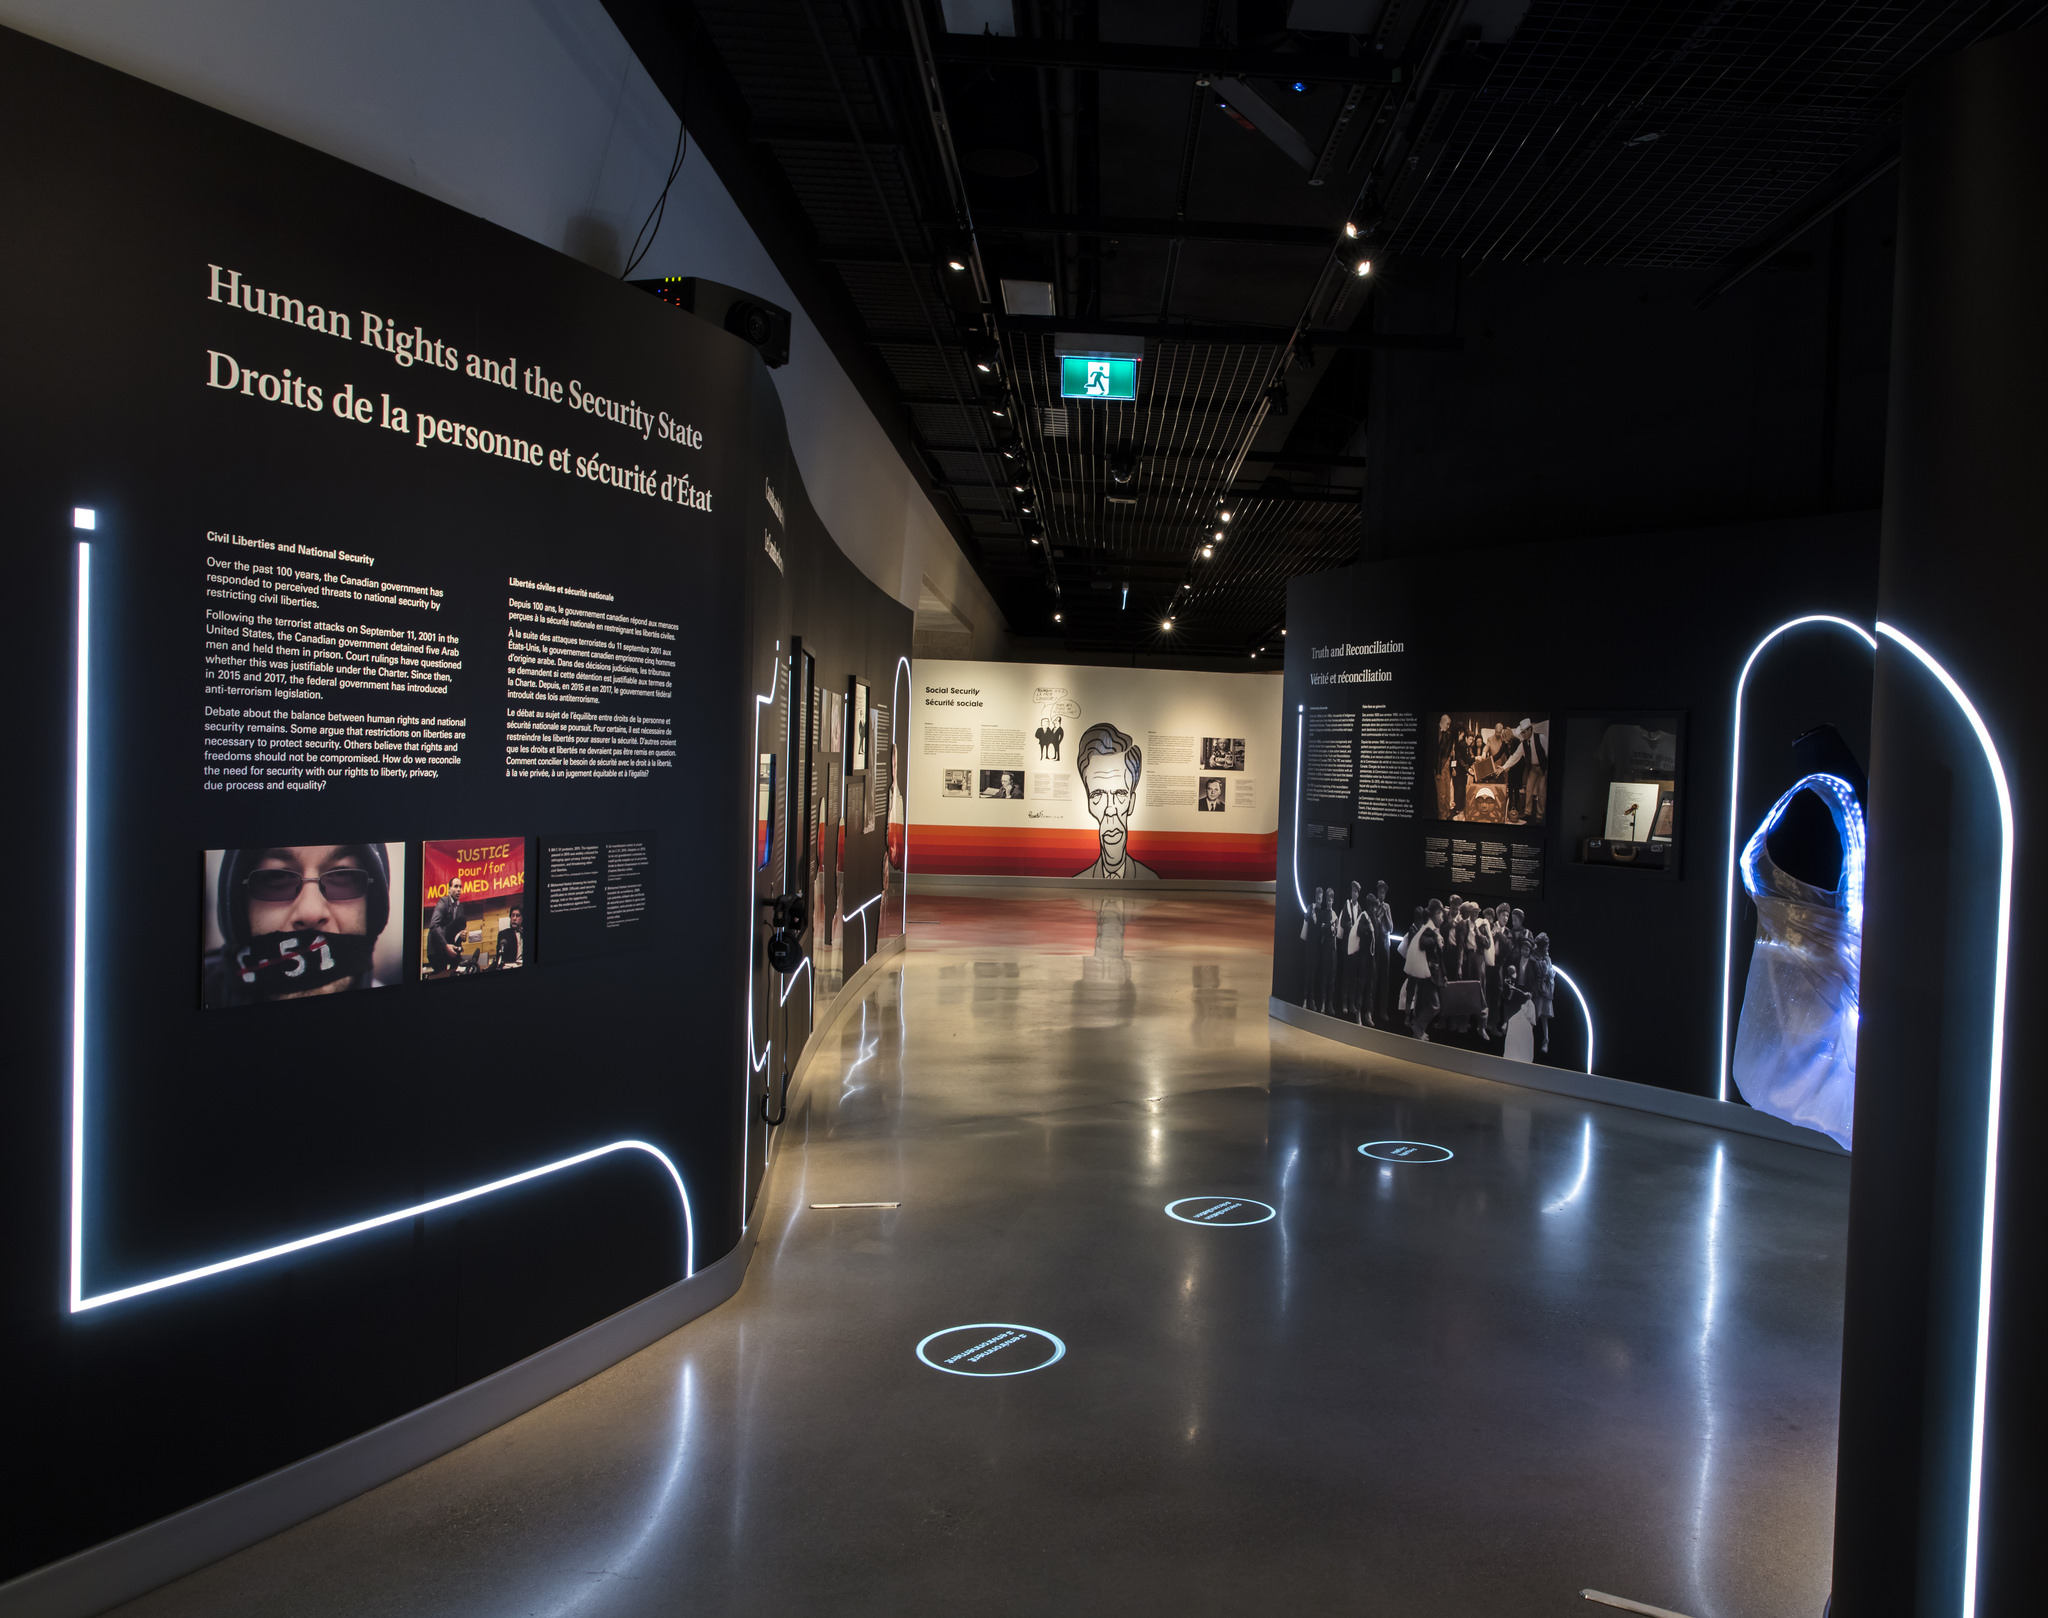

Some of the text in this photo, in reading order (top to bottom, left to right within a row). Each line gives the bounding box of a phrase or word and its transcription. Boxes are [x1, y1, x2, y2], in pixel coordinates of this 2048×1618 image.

[207, 264, 703, 450] Human Rights and the Security State
[206, 350, 323, 412] Droits
[333, 384, 373, 423] de
[380, 394, 410, 433] la
[417, 414, 544, 466] personne
[549, 448, 571, 474] et
[576, 452, 657, 497] sécurité
[207, 531, 375, 567] Civil Liberties and National Security
[207, 557, 444, 597] Over the past 100 years, the Canadian government has
[207, 574, 441, 612] responded to perceived threats to national security by
[207, 589, 319, 609] restricting civil liberties.
[509, 577, 614, 602] Libertés civiles et sécurité nationale
[206, 609, 459, 644] Following the terrorist attacks on September 11, 2001 in the
[206, 624, 460, 657] United States, the Canadian government detained five Arab
[1312, 641, 1404, 660] Truth and Reconciliation
[206, 642, 462, 670] men and held them in prison. Court rulings have questioned
[205, 655, 452, 683] whether this was justifiable under the Charter. Since then,
[1310, 669, 1392, 685] Vérité et réconciliation
[205, 684, 323, 700] anti-terrorism legislation.
[206, 669, 448, 694] in 2015 and 2017, the federal government has introduced
[950, 687, 980, 696] Security
[925, 698, 954, 706] Sécurité
[205, 706, 466, 727] Debate about the balance between human rights and national
[205, 722, 245, 734] security
[247, 724, 288, 733] remains.
[291, 724, 318, 734] Some
[319, 727, 345, 737] argue
[346, 726, 363, 736] that
[365, 728, 410, 738] restrictions
[423, 729, 453, 739] liberties
[204, 766, 220, 775] the
[223, 766, 248, 775] need
[250, 766, 264, 776] for
[266, 766, 304, 778] security
[305, 767, 325, 776] with
[344, 767, 369, 778] rights
[381, 767, 408, 778] liberty,
[409, 768, 439, 779] privacy,
[204, 780, 327, 792] due process and equality?
[456, 844, 510, 862] JUSTICE
